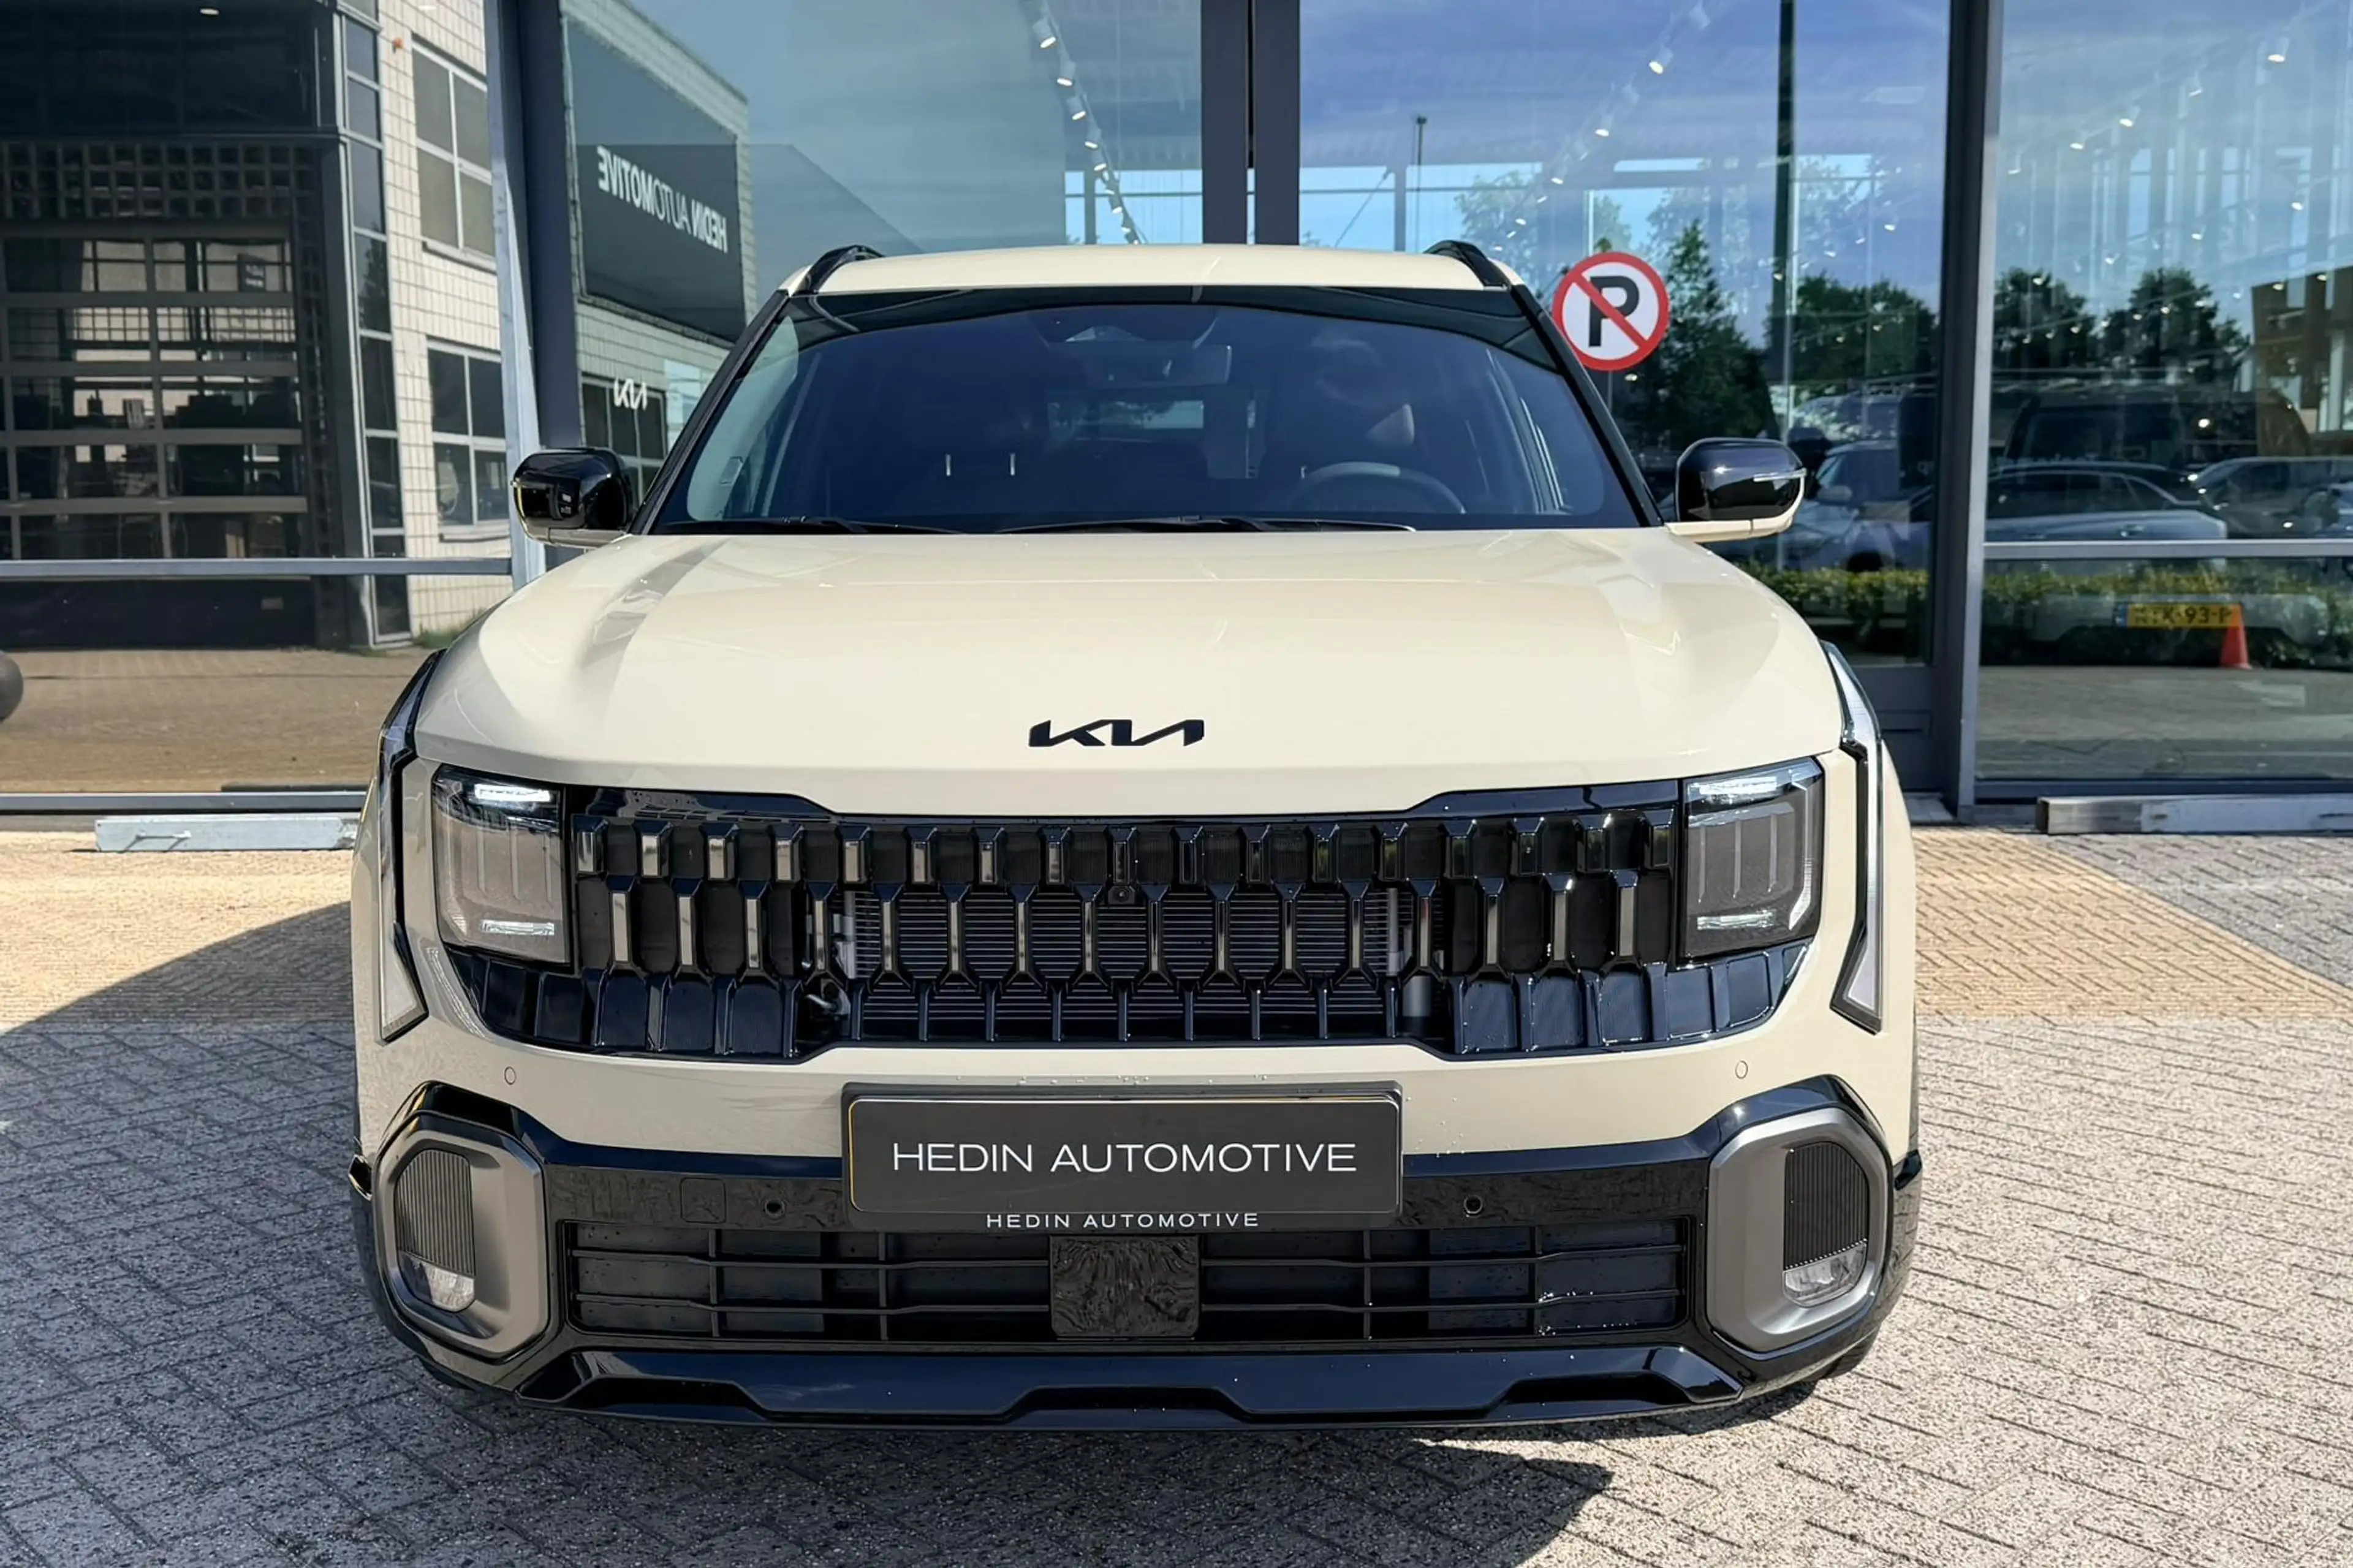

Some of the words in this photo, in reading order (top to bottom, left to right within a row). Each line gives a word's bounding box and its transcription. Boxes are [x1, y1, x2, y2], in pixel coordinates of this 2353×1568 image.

[1588, 275, 1640, 348] P
[1028, 719, 1205, 747] KIA
[893, 1143, 1033, 1172] HEDIN
[1050, 1143, 1357, 1173] AUTOMOTIVE
[987, 1214, 1070, 1228] HEDIN
[1083, 1213, 1259, 1228] AUTOMOTIVE
